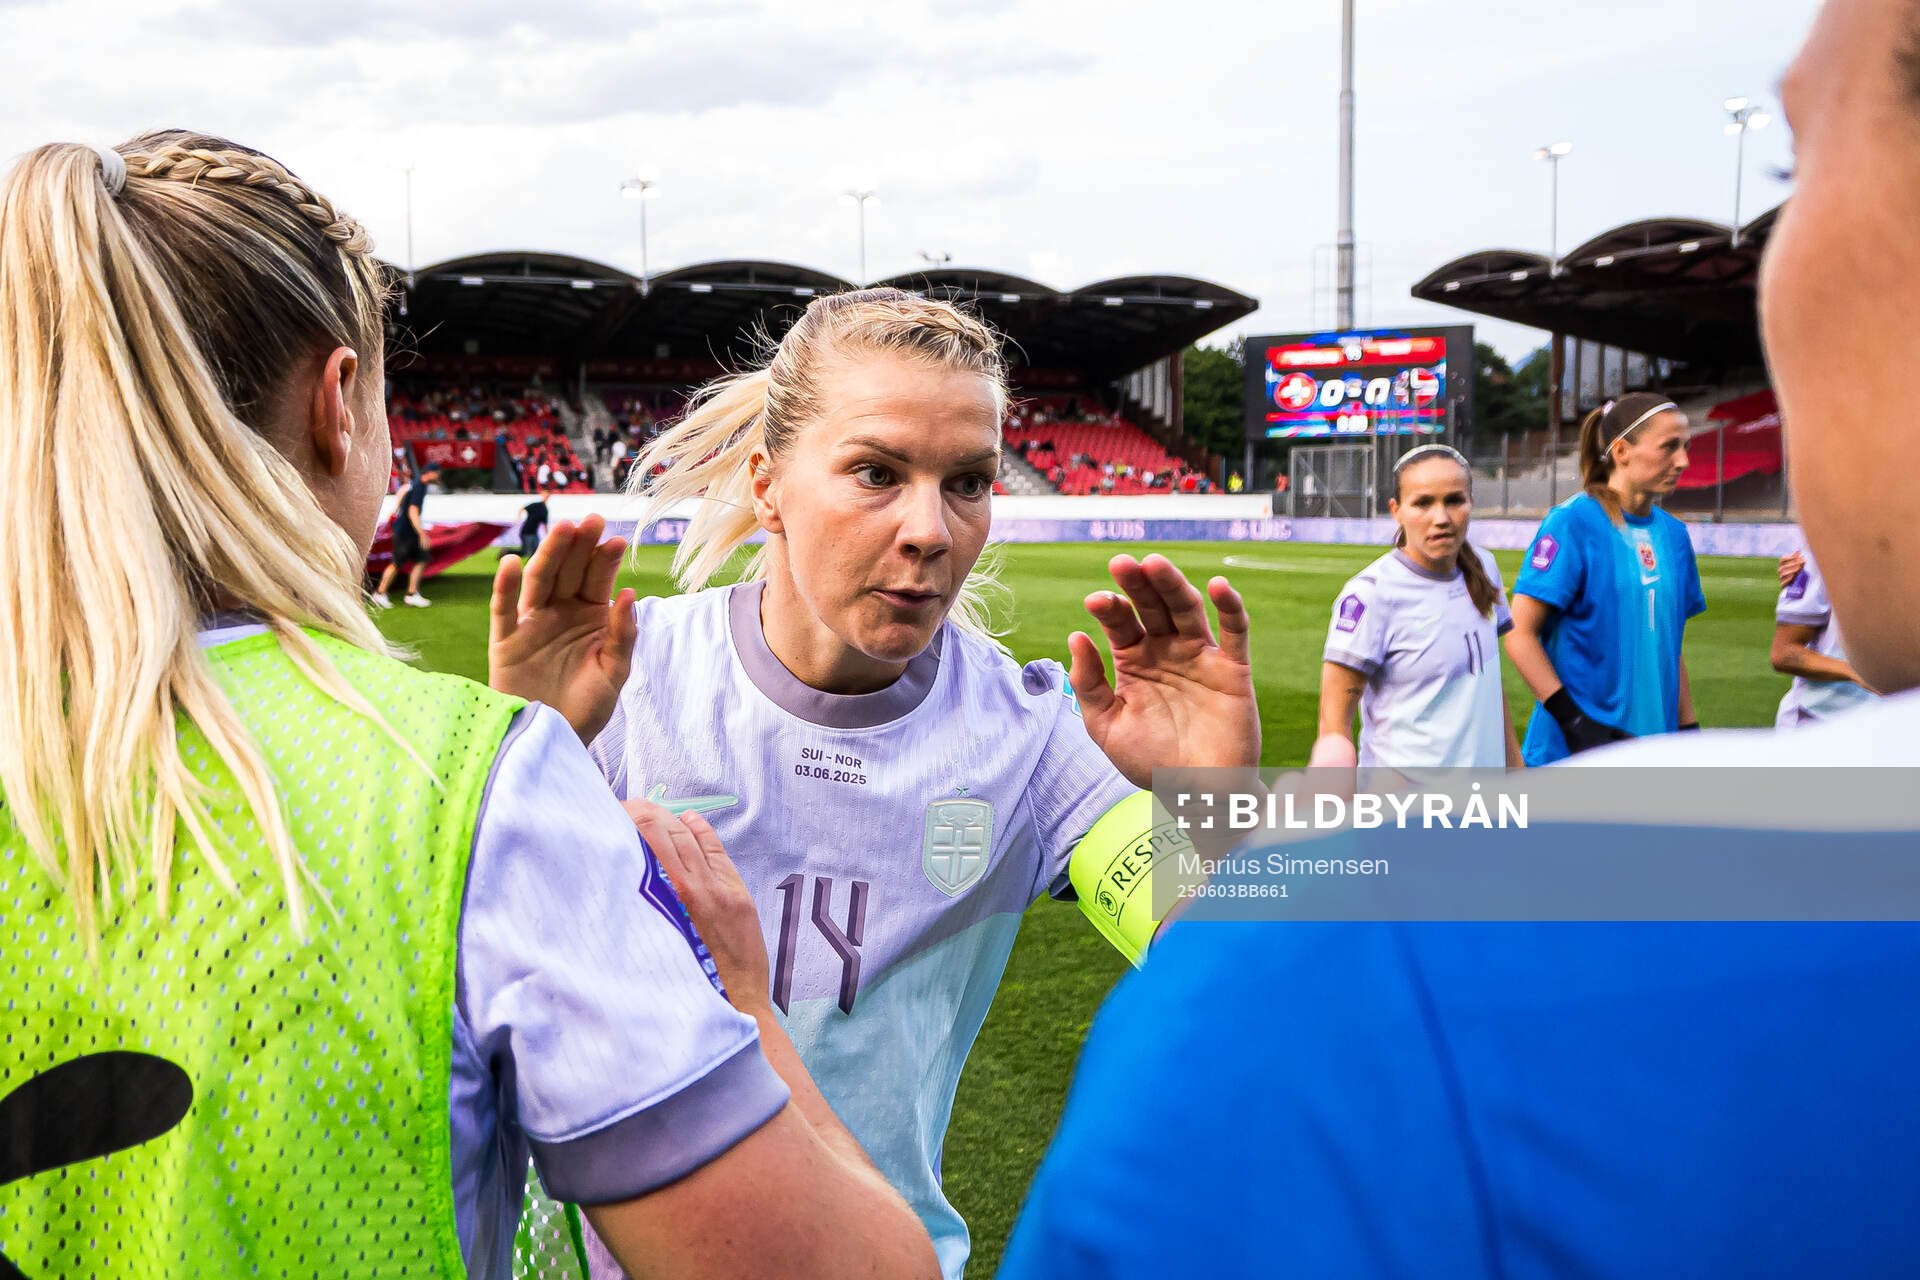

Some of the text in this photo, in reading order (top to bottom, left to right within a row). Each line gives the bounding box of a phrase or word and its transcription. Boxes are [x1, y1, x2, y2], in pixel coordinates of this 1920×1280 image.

[1648, 588, 1656, 632] 1
[1464, 630, 1484, 675] 11
[795, 764, 867, 785] 03.06.2025
[801, 747, 823, 762] SUI
[835, 753, 862, 769] NOR
[772, 873, 870, 1017] 14
